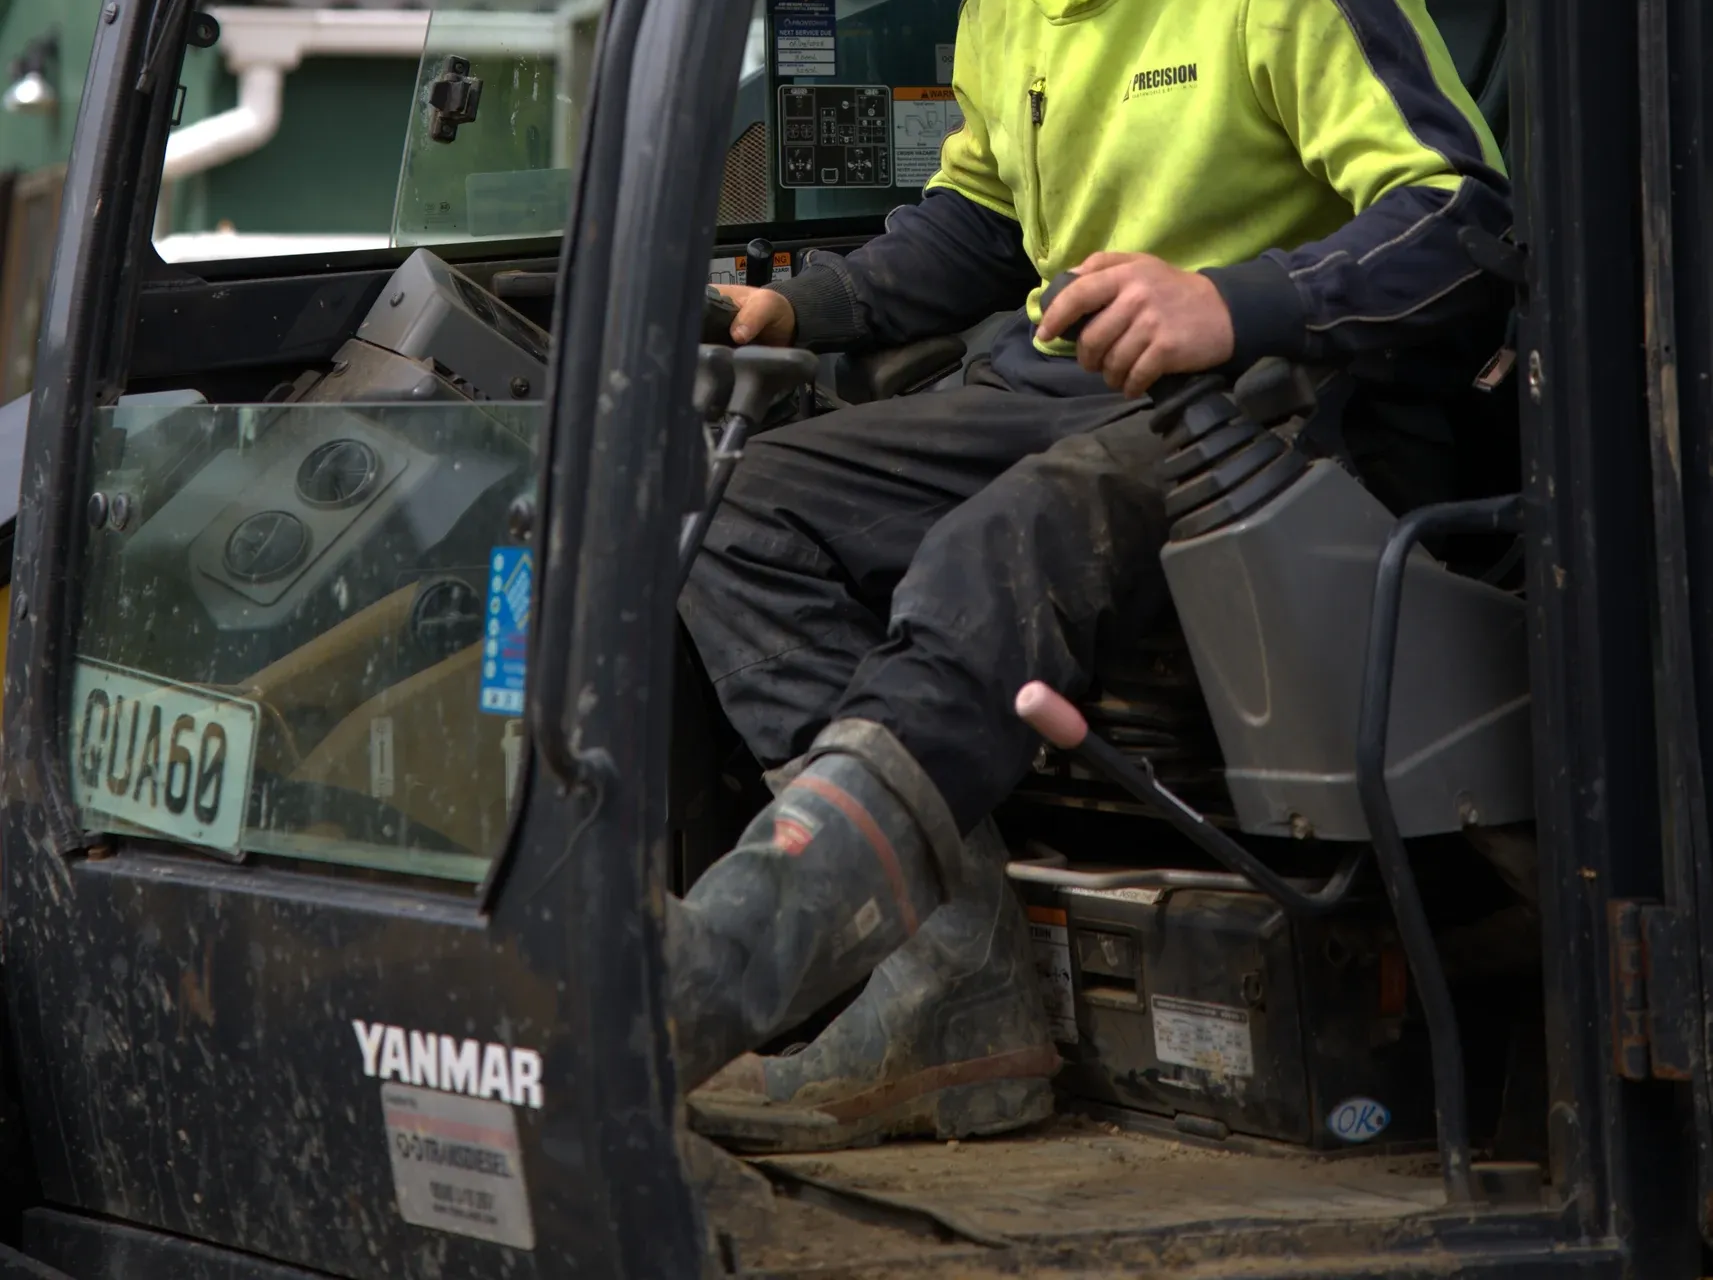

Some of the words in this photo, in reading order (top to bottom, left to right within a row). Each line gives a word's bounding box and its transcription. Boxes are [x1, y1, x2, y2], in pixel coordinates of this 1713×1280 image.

[1132, 63, 1198, 92] PRECISION
[929, 89, 955, 99] WARN
[80, 687, 228, 826] QUA60
[351, 1018, 544, 1110] YANMAR
[1337, 1105, 1377, 1134] OK
